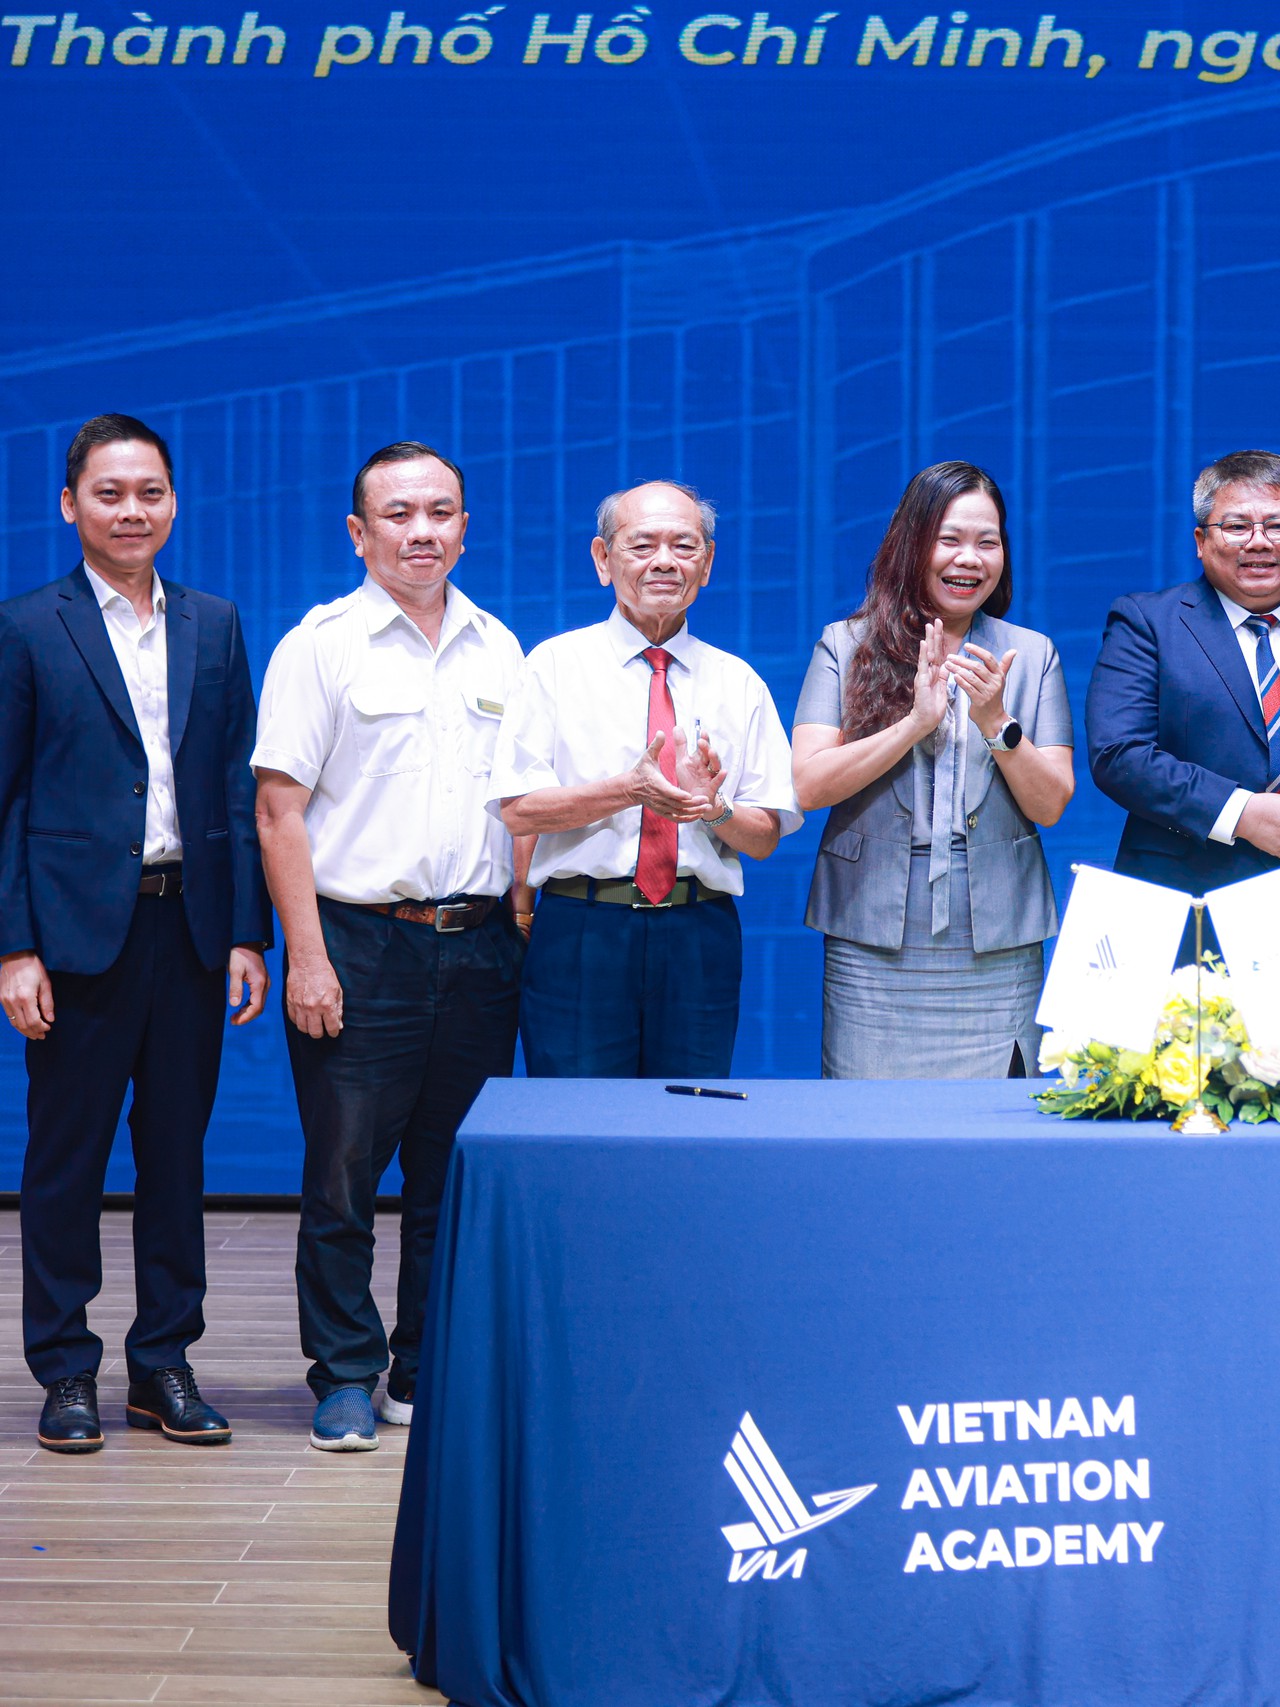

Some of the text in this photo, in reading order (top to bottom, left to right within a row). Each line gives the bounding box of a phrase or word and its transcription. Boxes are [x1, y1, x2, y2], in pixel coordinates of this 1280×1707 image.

[1, 12, 287, 67] Thành
[314, 6, 507, 78] phố
[523, 6, 652, 66] Hồ
[679, 12, 840, 66] Chí
[856, 11, 1107, 79] Minh,
[897, 1395, 1137, 1446] VIETNAM
[901, 1458, 1151, 1510] AVIATION
[904, 1521, 1165, 1574] ACADEMY
